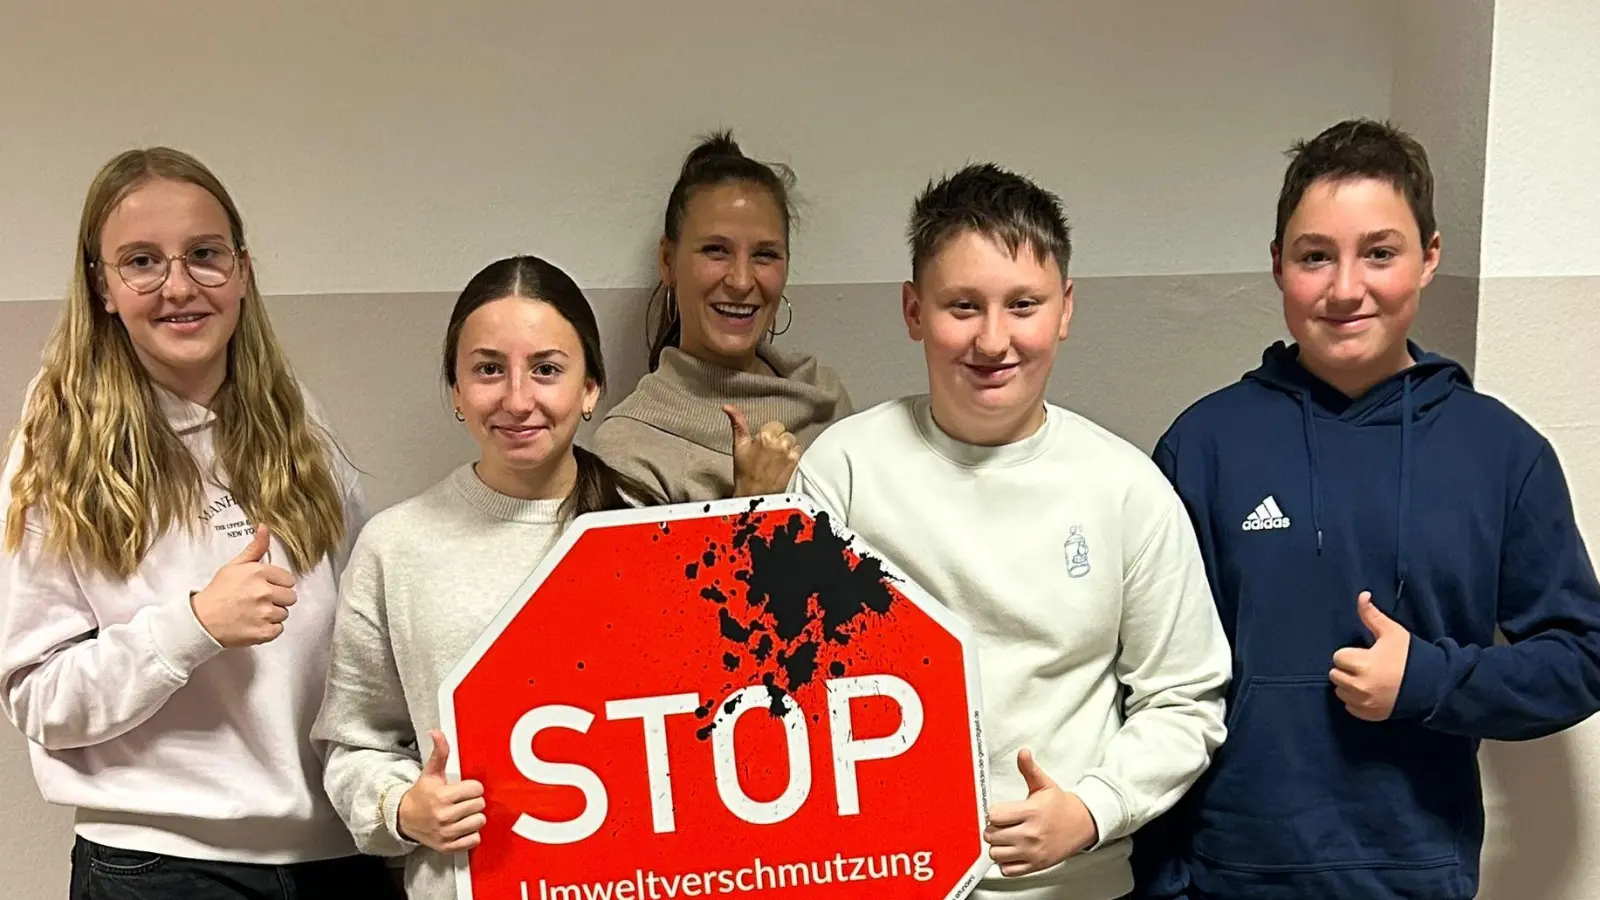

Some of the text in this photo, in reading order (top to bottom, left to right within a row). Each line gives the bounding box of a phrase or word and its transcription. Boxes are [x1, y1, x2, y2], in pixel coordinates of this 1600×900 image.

[198, 495, 237, 523] MANH
[226, 521, 244, 529] UPPER
[227, 527, 256, 538] NEW YO
[1242, 517, 1290, 530] adidas
[510, 674, 924, 845] STOP
[520, 850, 934, 900] Umweltverschmutzung
